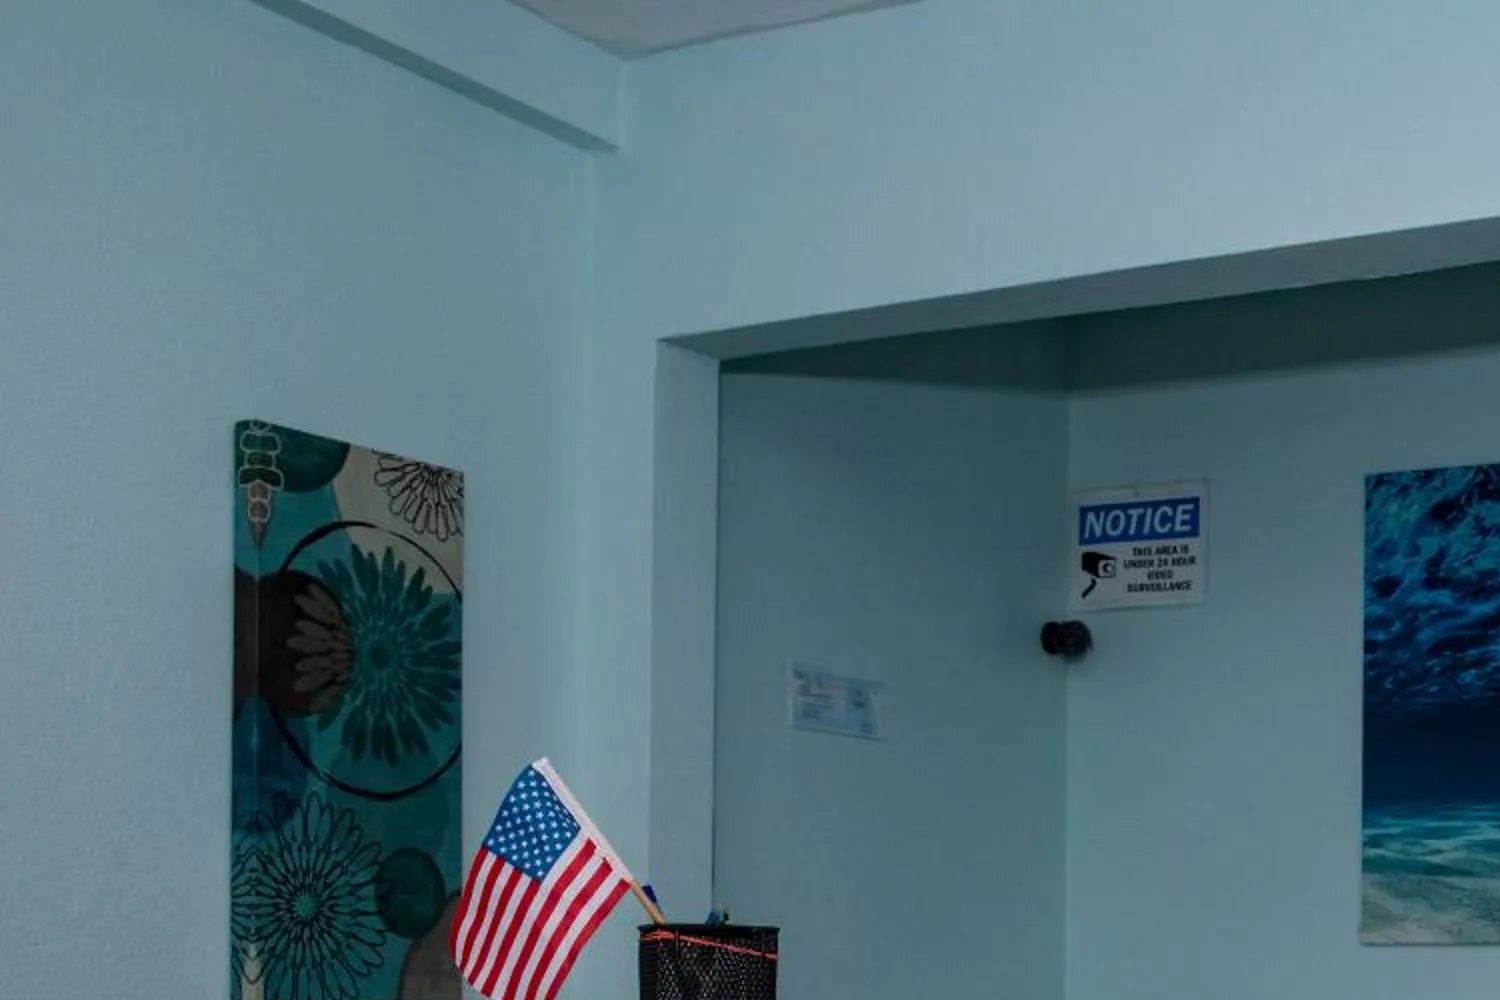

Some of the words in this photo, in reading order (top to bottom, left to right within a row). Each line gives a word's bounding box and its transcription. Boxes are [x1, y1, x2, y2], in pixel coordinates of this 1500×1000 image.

[1085, 504, 1195, 539] NOTICE
[1154, 545, 1178, 555] AREA
[1123, 559, 1154, 568] UNDER
[1171, 555, 1196, 566] HOUR
[1127, 580, 1192, 592] SURVEILLANCE
